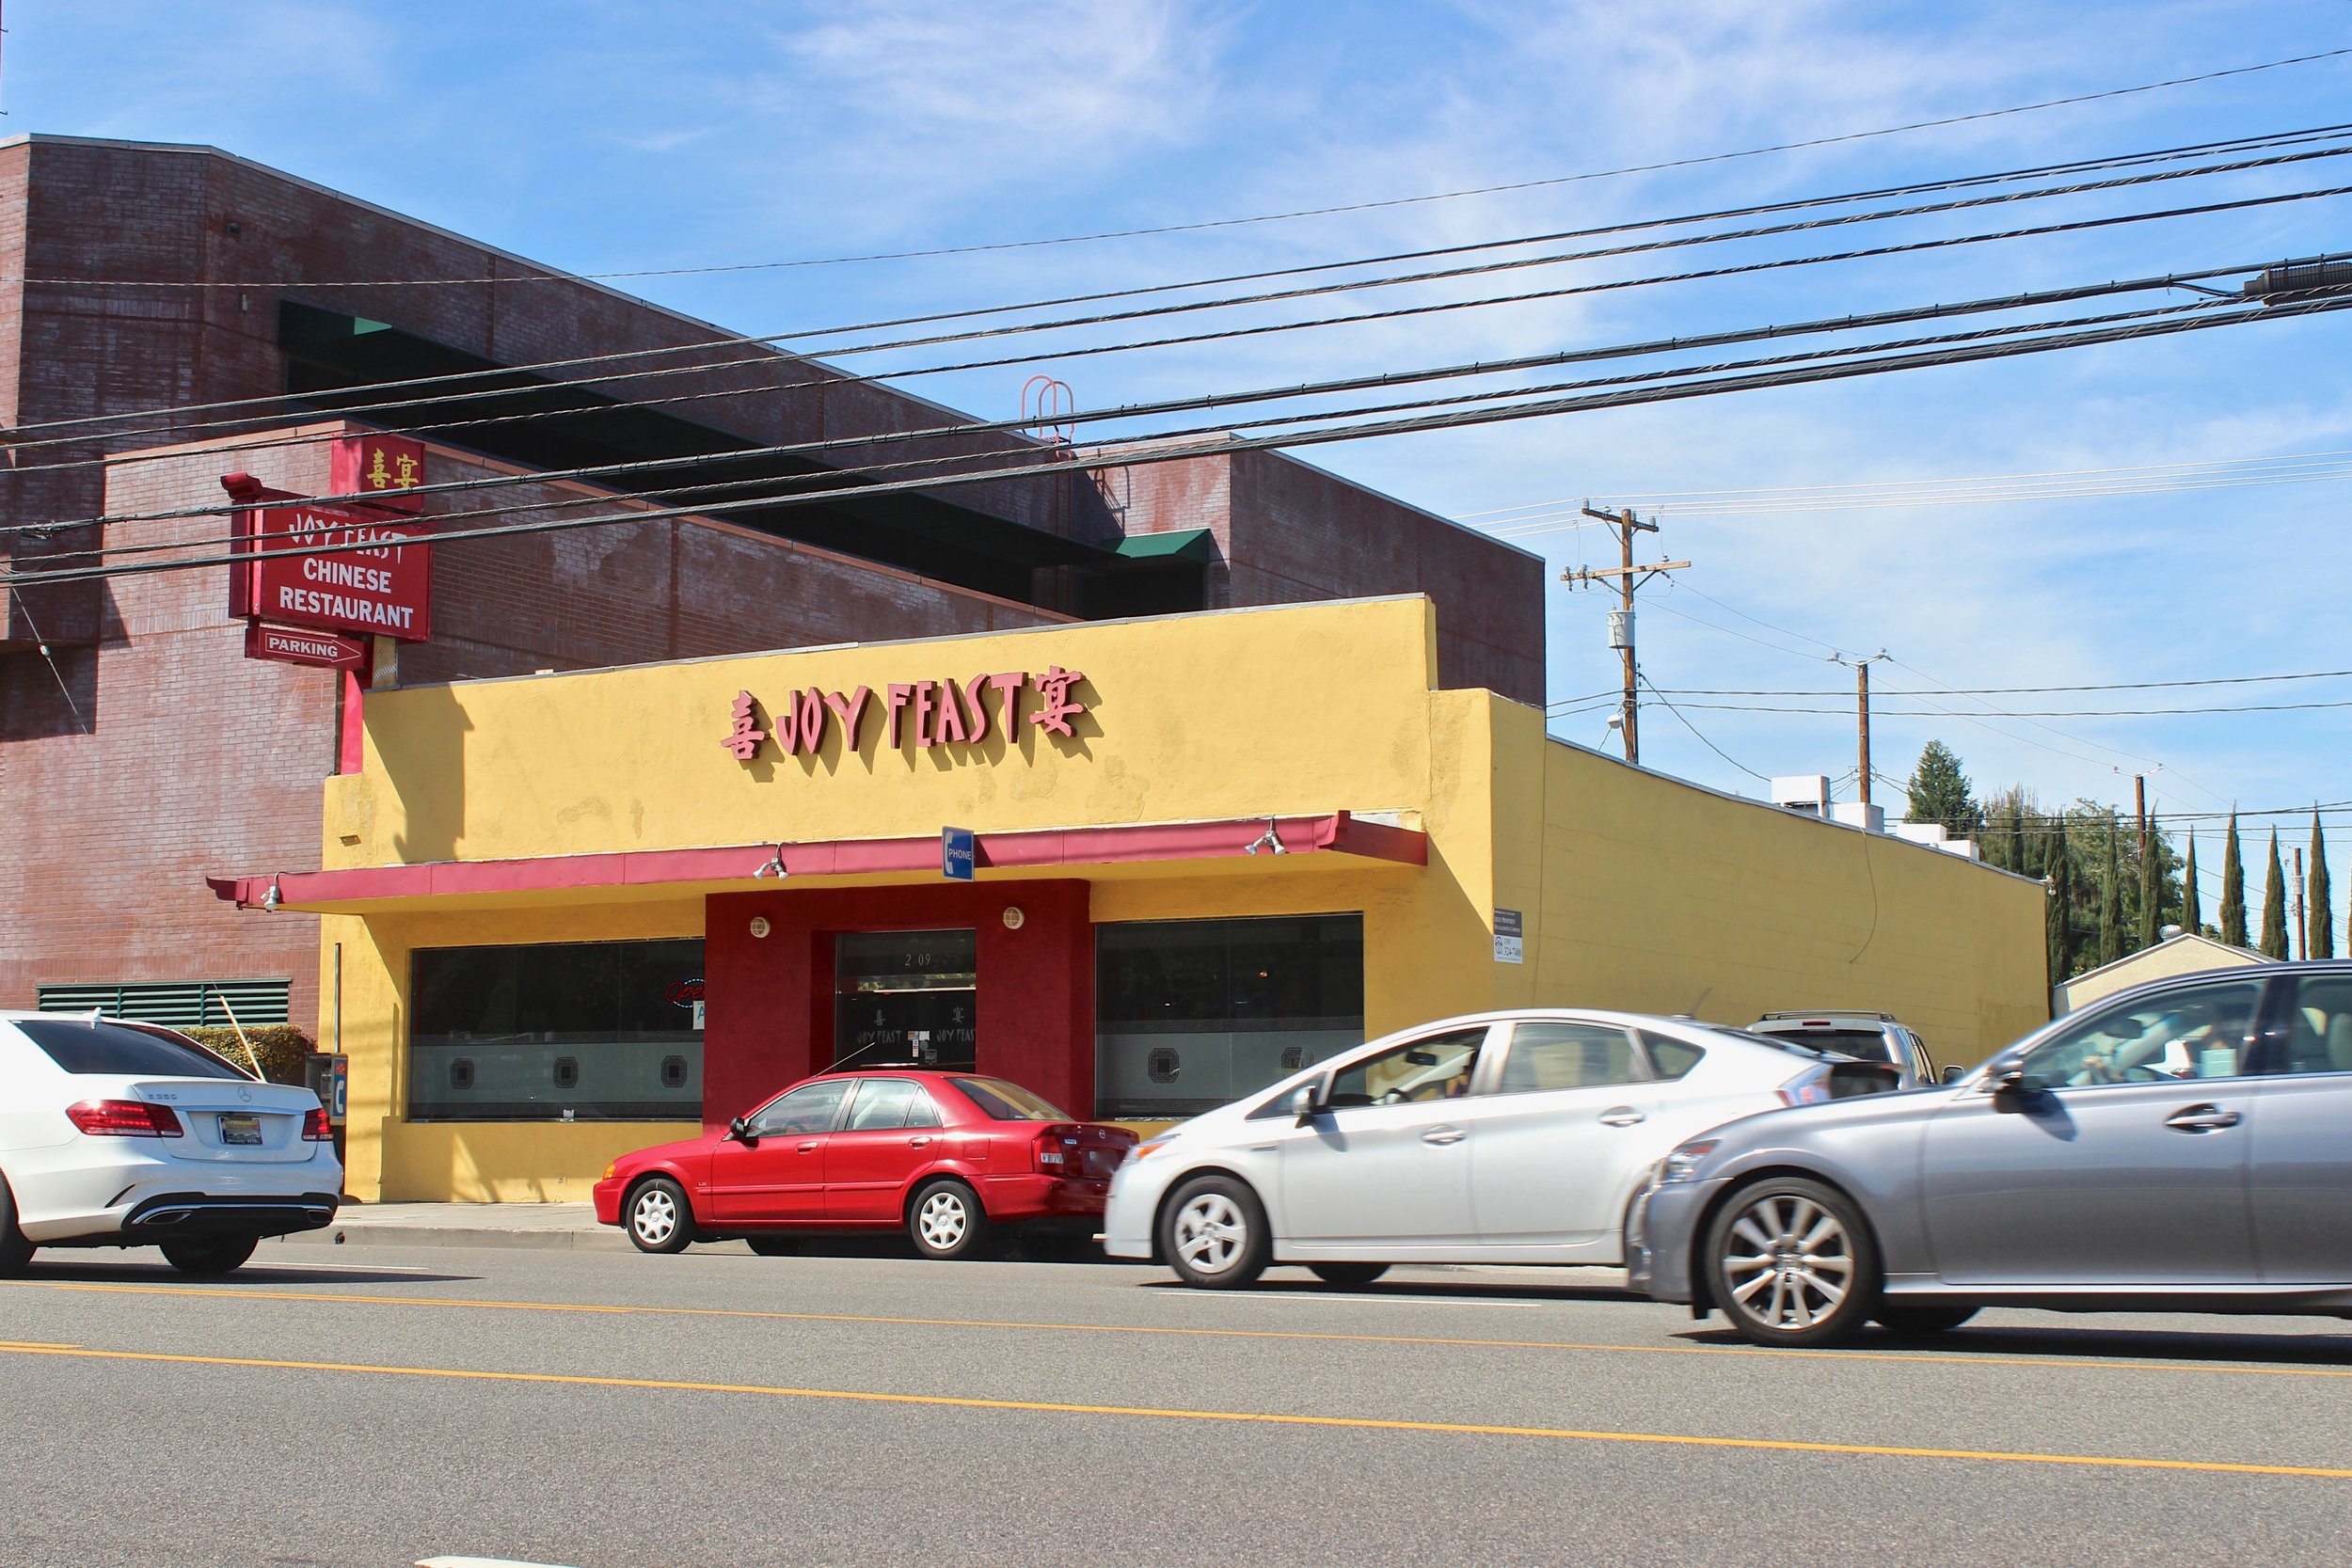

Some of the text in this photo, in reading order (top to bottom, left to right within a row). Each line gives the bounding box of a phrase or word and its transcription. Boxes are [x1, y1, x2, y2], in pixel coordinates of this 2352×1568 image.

[367, 448, 419, 489] 喜宴
[289, 514, 407, 564] JOY FEAST
[303, 558, 392, 594] CHINESE
[279, 586, 414, 629] RESTAURANT
[269, 637, 339, 657] PARKING
[776, 672, 1028, 756] JOY FEAST
[1028, 665, 1089, 737] 宴
[721, 689, 770, 761] 喜
[948, 847, 972, 861] PHONE
[664, 982, 705, 1003] Ope
[858, 1031, 875, 1043] JOY
[878, 1031, 901, 1042] FEAST
[937, 1029, 975, 1041] JOY FEAS
